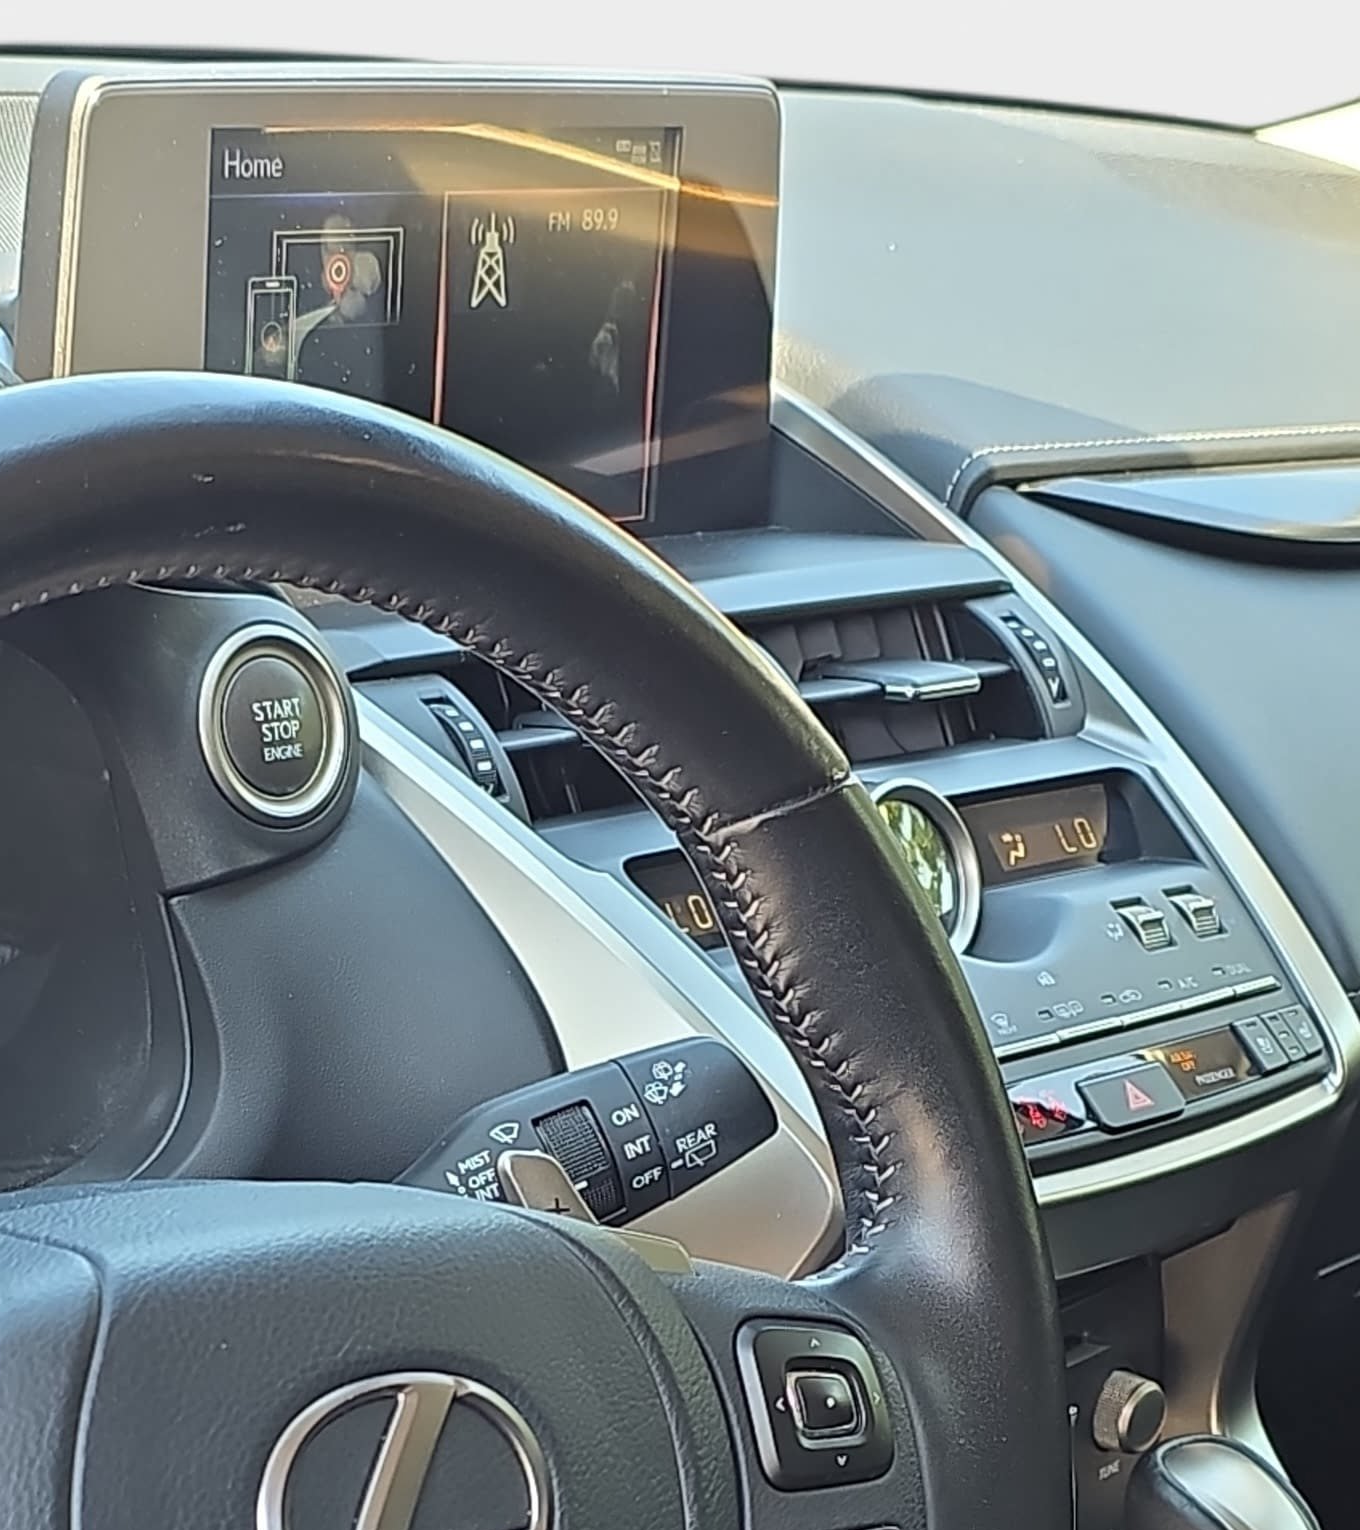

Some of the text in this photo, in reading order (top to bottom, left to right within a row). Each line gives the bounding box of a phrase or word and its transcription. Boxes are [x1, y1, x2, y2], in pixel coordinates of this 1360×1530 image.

[222, 149, 283, 179] Home
[548, 207, 619, 233] FM 89.9
[251, 697, 301, 722] START
[261, 720, 300, 743] STOP
[263, 744, 304, 762] ENGINE
[610, 1103, 641, 1126] ON
[623, 1134, 651, 1160] INT
[675, 1122, 718, 1153] REAR
[457, 1149, 491, 1175] MIST
[468, 1167, 496, 1189] OFF
[632, 1166, 663, 1189] OFF
[474, 1182, 500, 1201] INT
